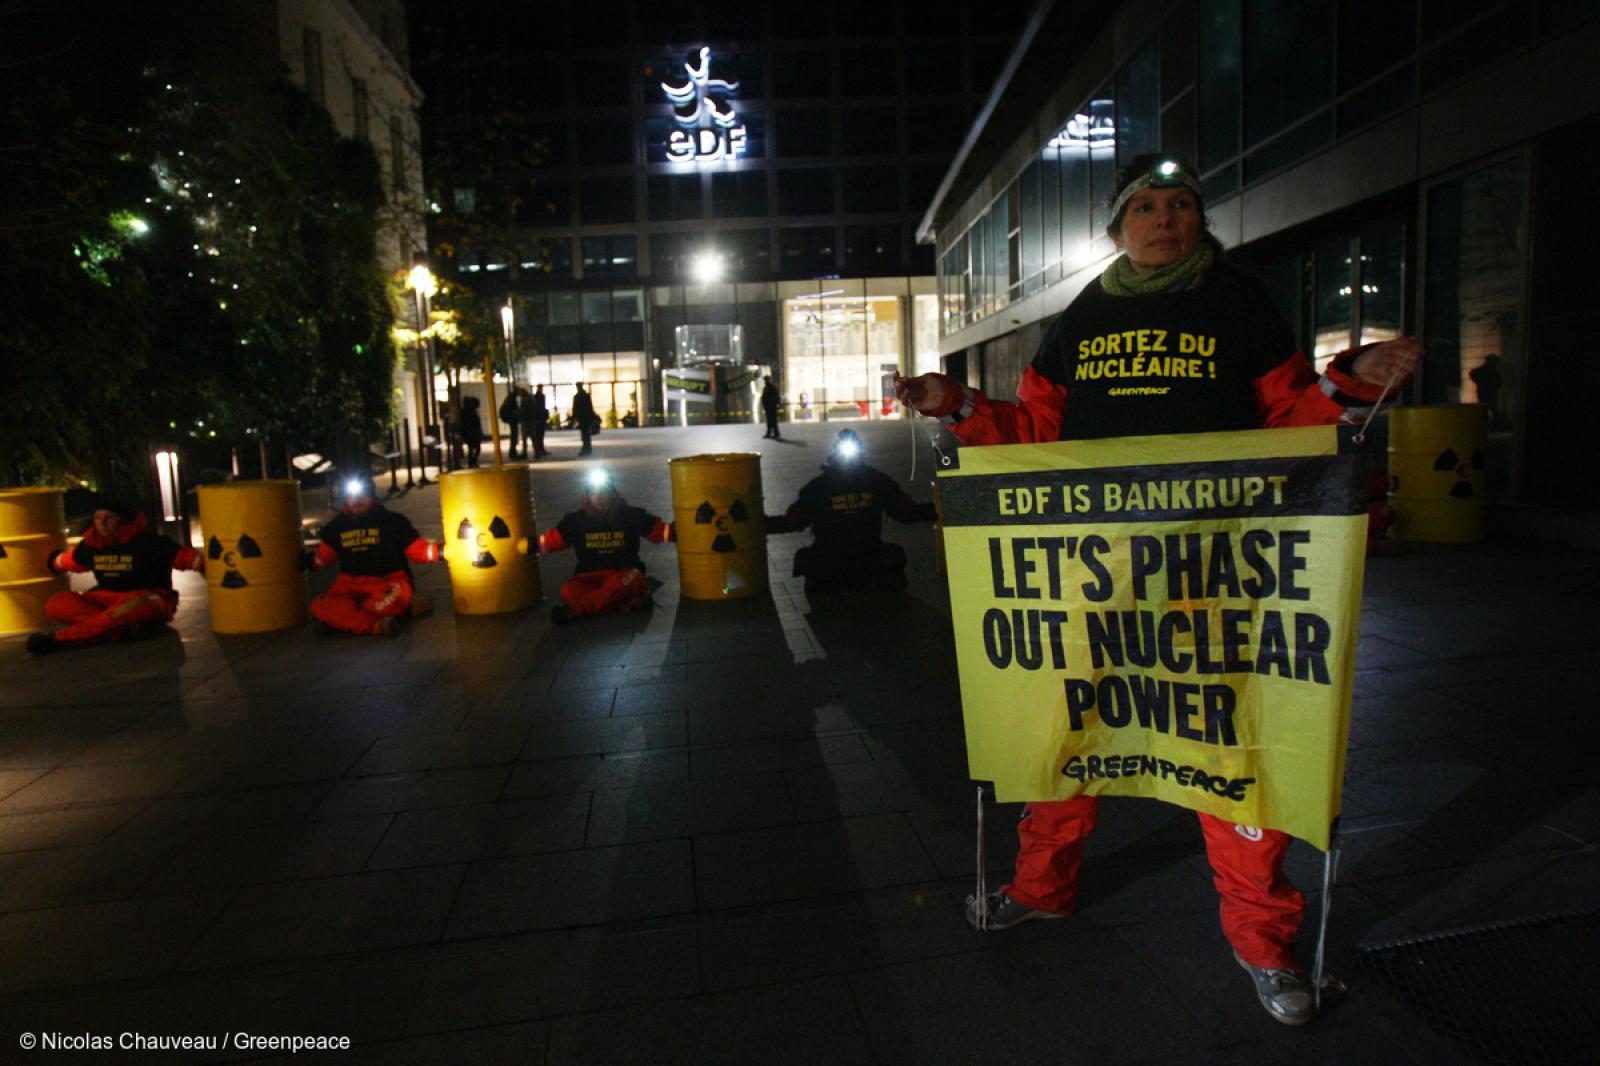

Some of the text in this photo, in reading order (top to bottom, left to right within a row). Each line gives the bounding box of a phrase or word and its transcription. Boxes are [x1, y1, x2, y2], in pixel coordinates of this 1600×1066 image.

[1074, 352, 1203, 381] NUCLÉAIRE
[1077, 328, 1217, 361] SORTEZ DU
[997, 475, 1288, 516] EDF IS BANKRUPT
[988, 528, 1312, 602] LET'S PHASE
[982, 607, 1332, 685] OUT NUCLEAR
[1063, 675, 1239, 746] POWER
[1061, 755, 1257, 801] GREENPEACE
